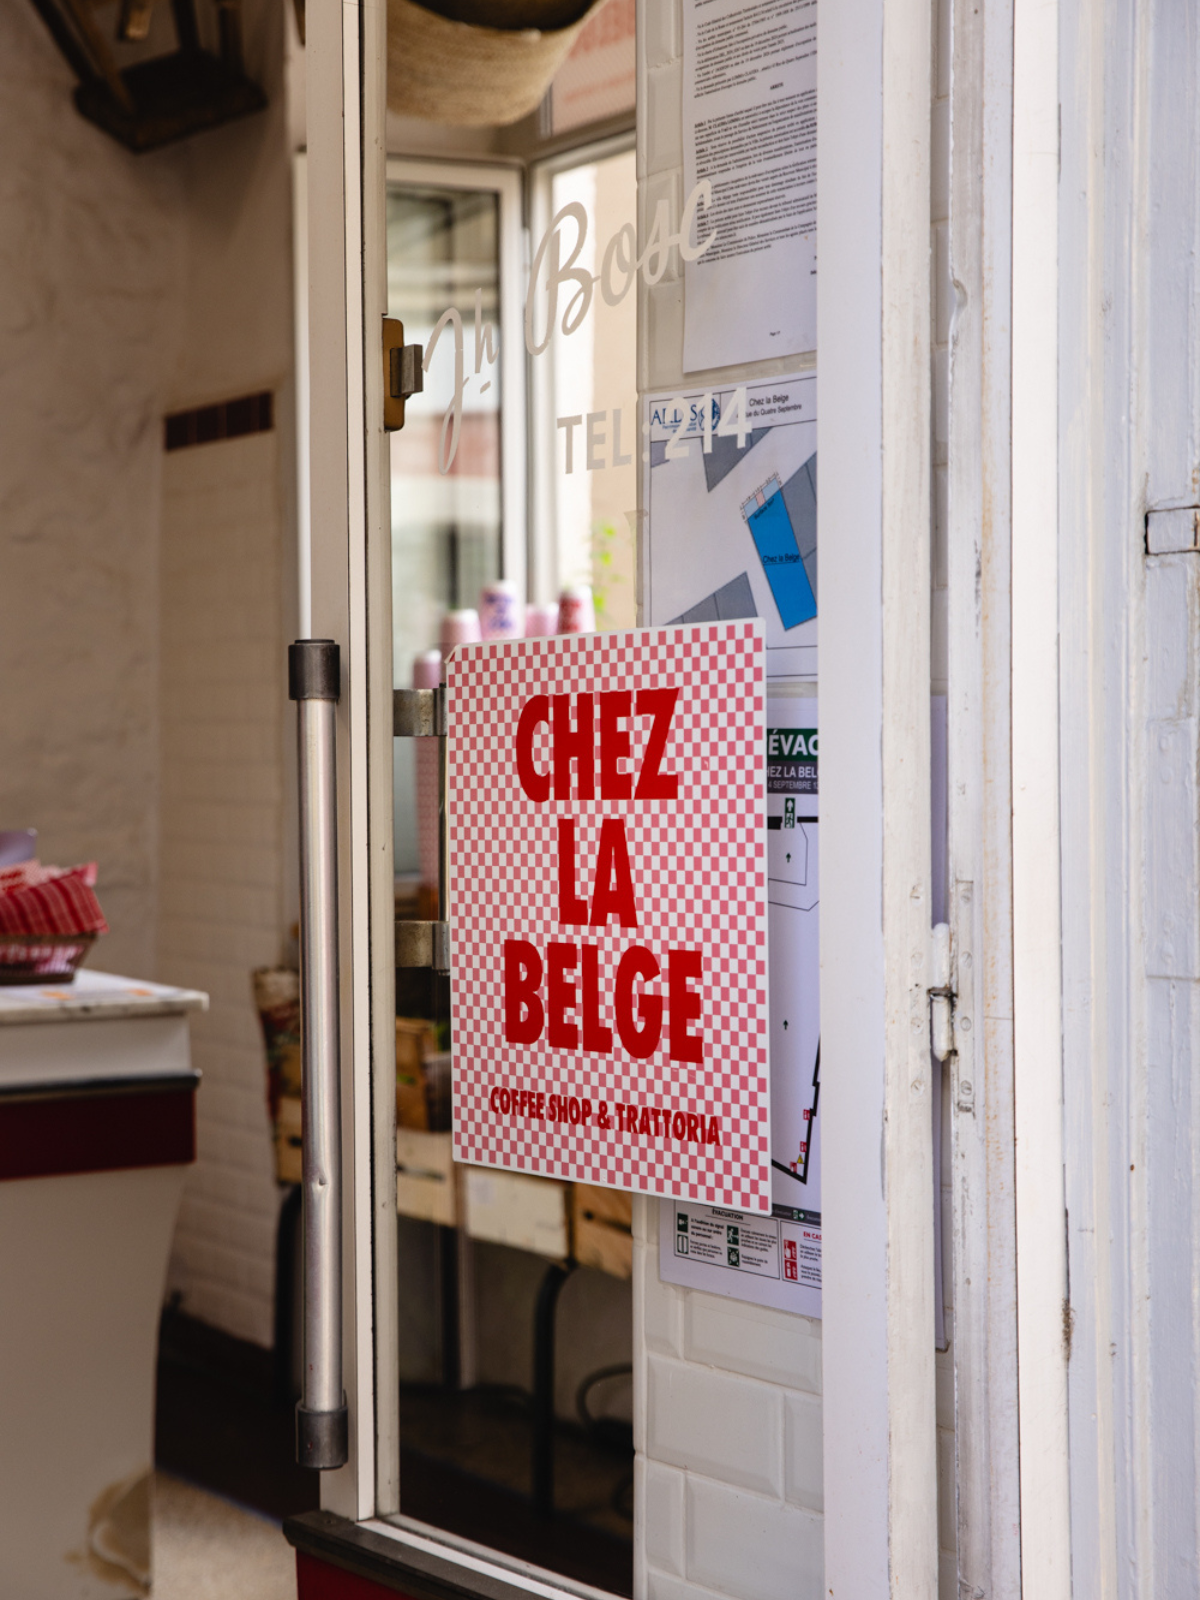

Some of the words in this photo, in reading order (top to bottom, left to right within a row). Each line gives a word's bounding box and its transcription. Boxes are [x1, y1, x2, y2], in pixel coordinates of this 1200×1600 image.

[525, 180, 717, 356] Bosc
[664, 386, 753, 461] 214
[749, 397, 765, 407] Chez
[766, 396, 772, 405] la
[772, 394, 789, 404] Belge
[760, 406, 777, 416] Quatre
[777, 403, 802, 414] Septembre
[762, 555, 777, 564] Chez
[778, 554, 784, 562] la
[515, 687, 679, 803] CHEZ
[783, 766, 797, 778] LA
[798, 766, 818, 778] BEL
[772, 780, 811, 790] SEPTEMBRE
[558, 817, 638, 929] LA
[504, 938, 704, 1064] BELGE
[490, 1085, 545, 1120] COFFEE
[548, 1093, 592, 1126] SHOP
[597, 1100, 611, 1130] &
[614, 1102, 721, 1147] TRATTORIA
